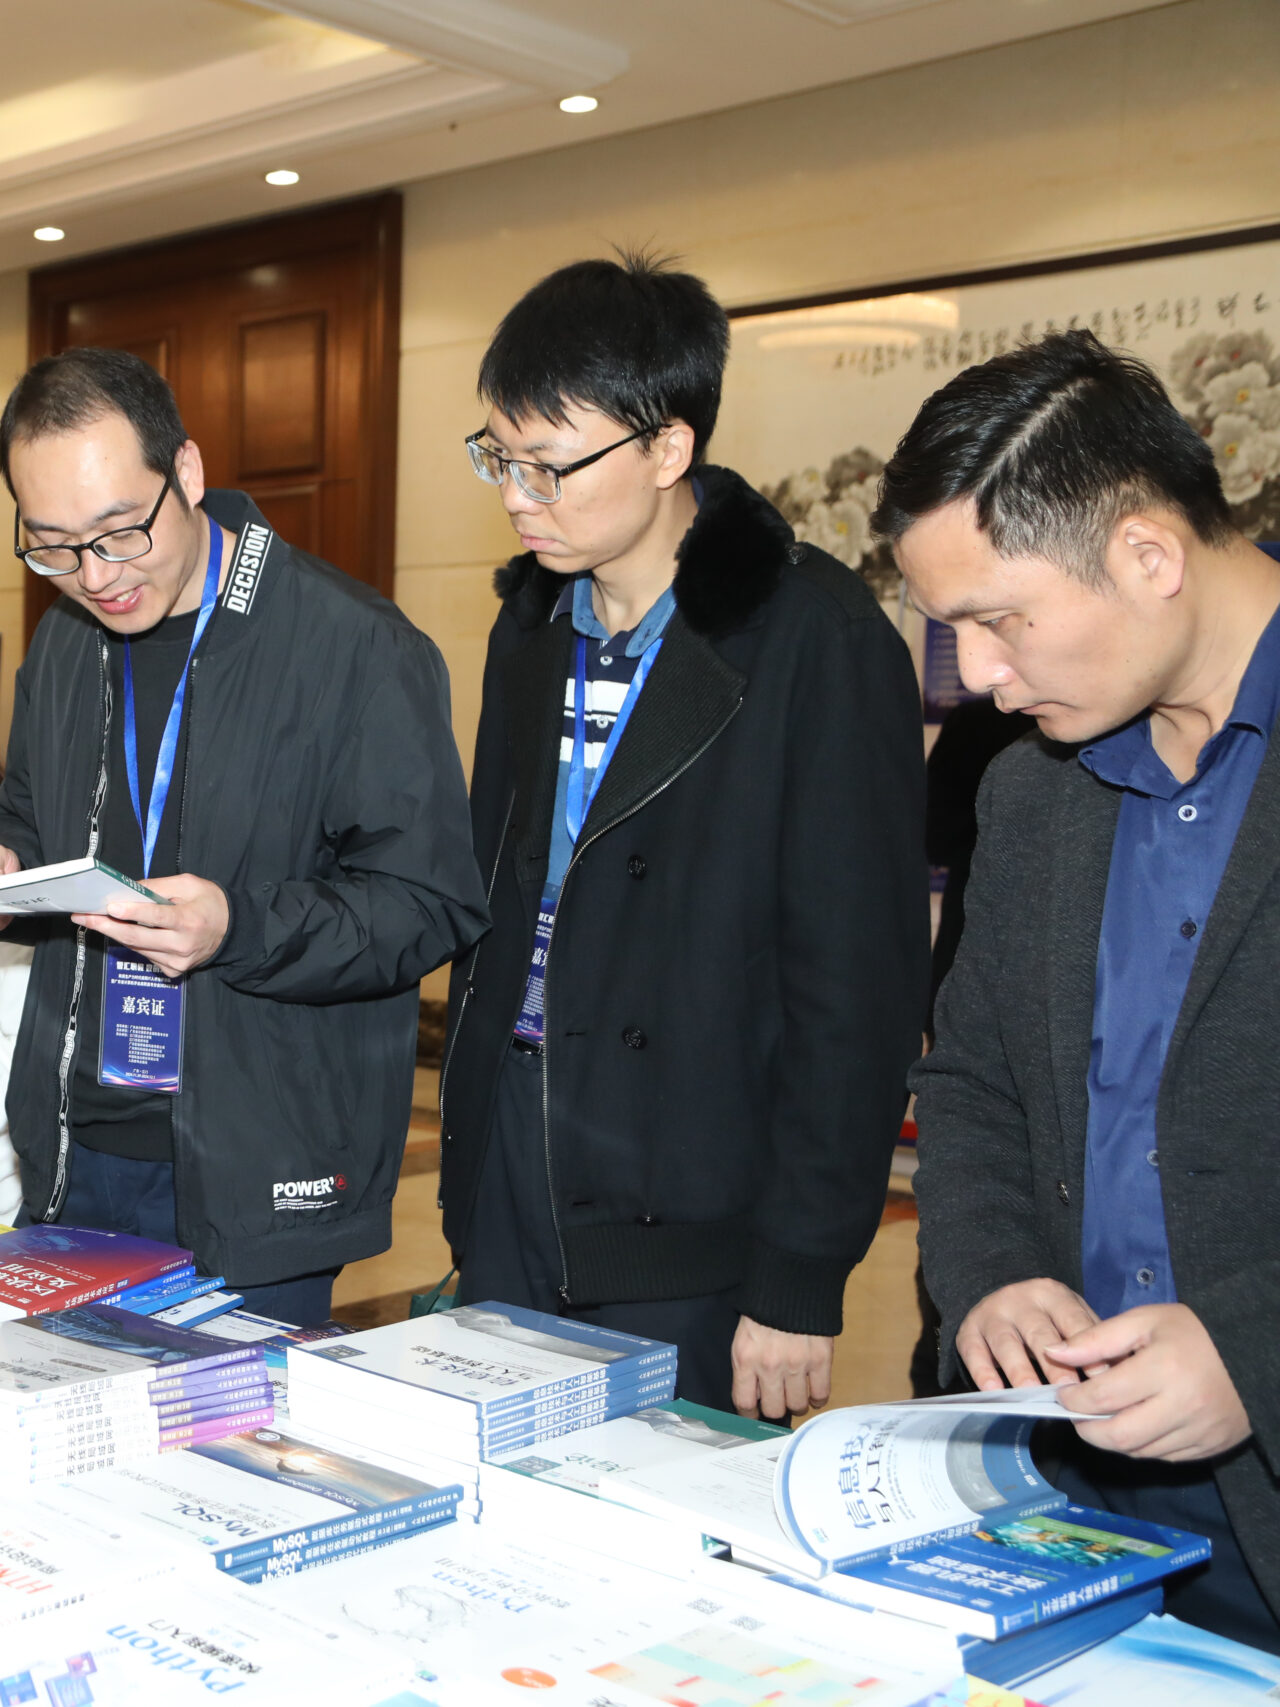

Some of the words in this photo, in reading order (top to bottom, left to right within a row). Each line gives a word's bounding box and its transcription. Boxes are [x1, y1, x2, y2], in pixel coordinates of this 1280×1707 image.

[226, 523, 269, 614] DECISION
[122, 996, 165, 1017] 嘉宾证
[0, 1263, 79, 1290] 及应用
[64, 1282, 114, 1309] 区块链技术及应用
[415, 1358, 519, 1387] 信息技术
[533, 1368, 606, 1400] 信息技术与人工智能基础
[534, 1383, 607, 1415] 信息技术与人工智能基础
[534, 1398, 606, 1430] 信息技术与人工智能基础
[173, 1501, 258, 1537] MySQL
[272, 1531, 310, 1553] MySQL
[267, 1549, 303, 1572] MySQL
[888, 1553, 1026, 1597] 工业机器人
[926, 1554, 1048, 1591] 技术基础
[432, 1571, 533, 1613] Python
[1041, 1575, 1119, 1616] 工业机器人技术基础
[105, 1623, 247, 1695] Python
